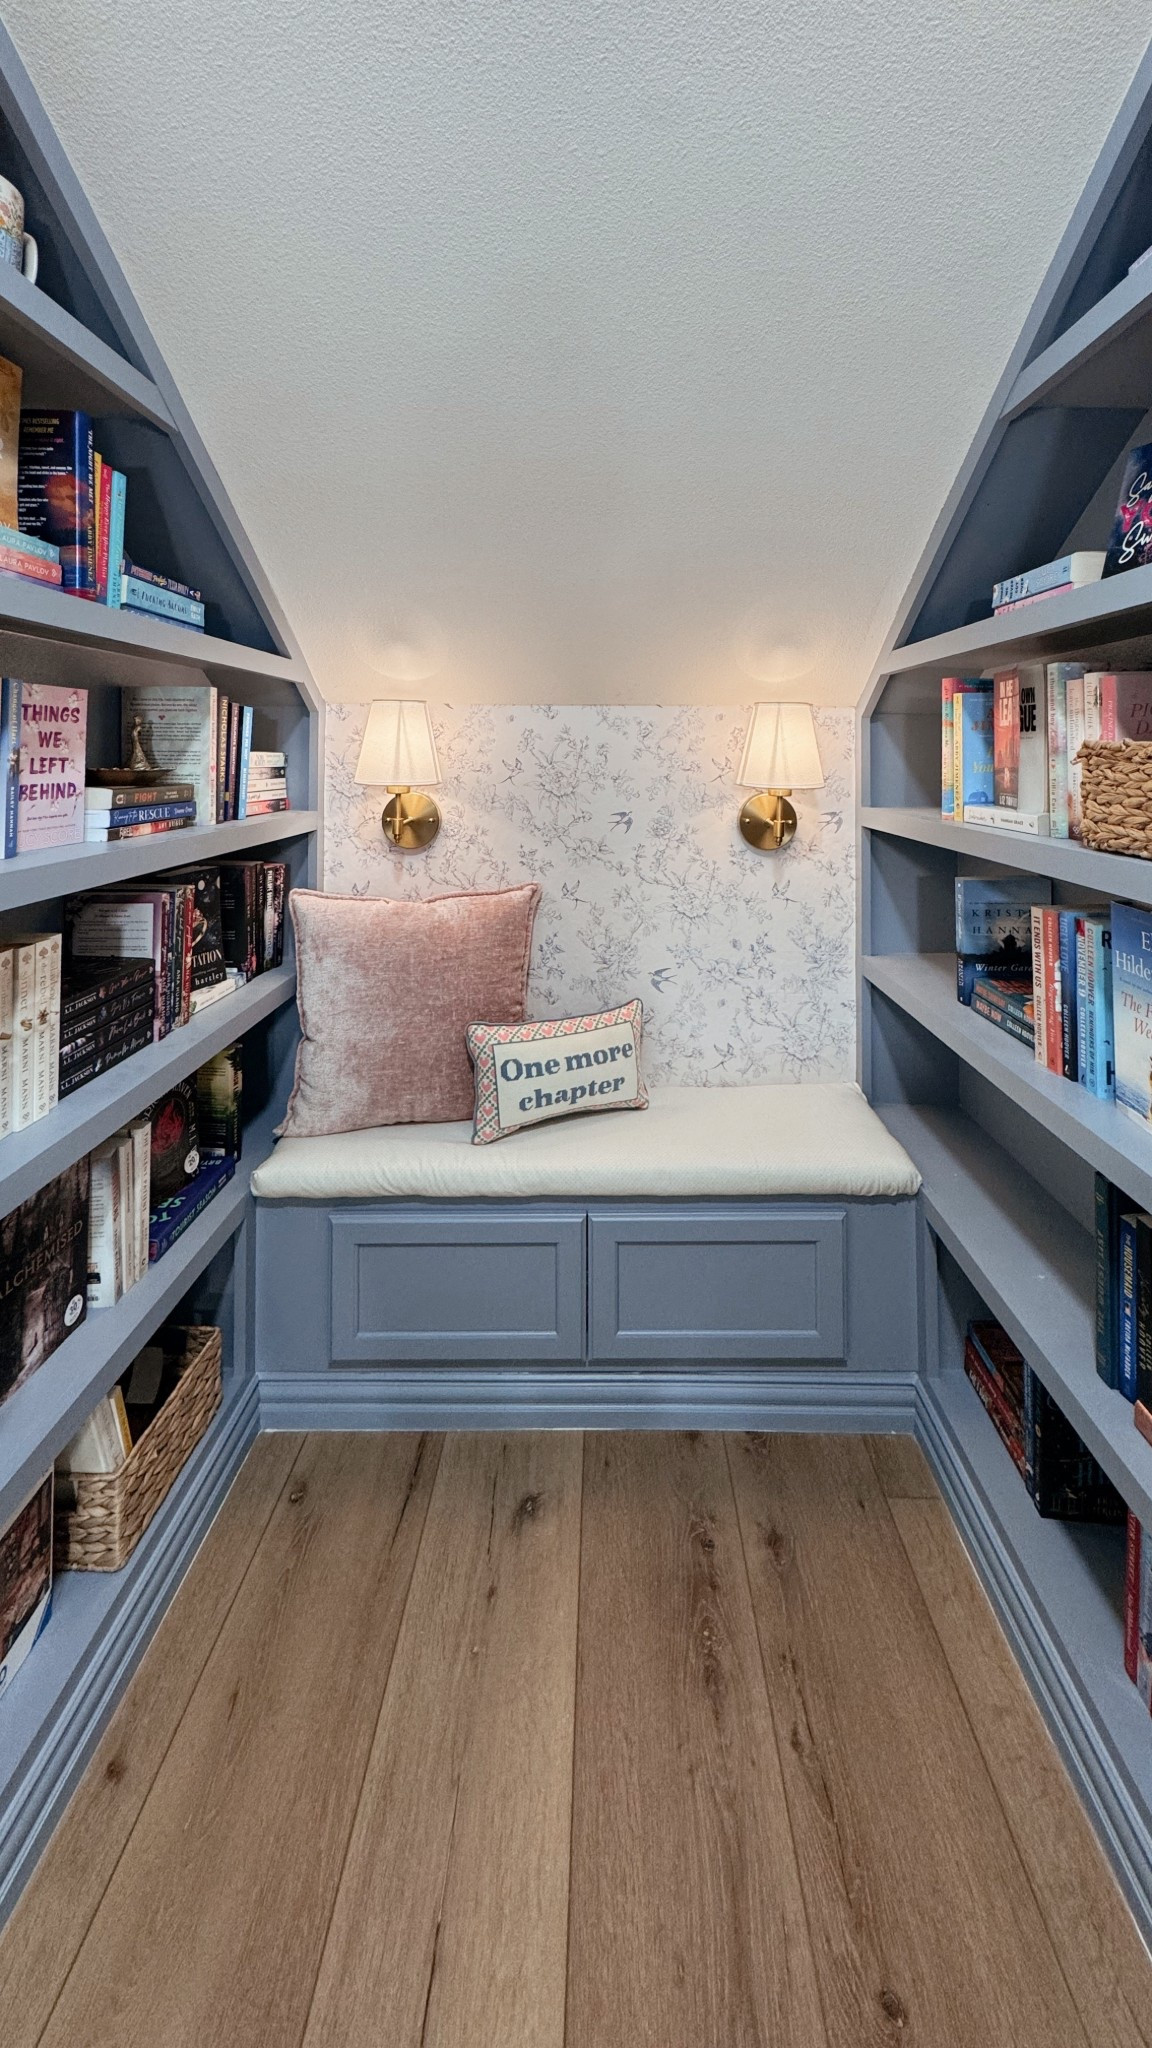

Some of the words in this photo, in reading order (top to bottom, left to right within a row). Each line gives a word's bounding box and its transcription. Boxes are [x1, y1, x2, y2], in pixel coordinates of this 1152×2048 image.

[88, 473, 94, 486] WE
[1126, 471, 1152, 508] Sa
[0, 535, 20, 546] AURA
[22, 542, 47, 556] PAVLOV
[24, 562, 50, 576] PAVLOV
[1020, 687, 1036, 704] OWN
[12, 712, 18, 723] of
[22, 704, 81, 724] THINGS
[1130, 703, 1152, 718] PI
[220, 699, 228, 748] NICHOLAS
[38, 730, 62, 748] WE
[30, 757, 70, 774] LEFT
[18, 782, 77, 802] BEHIND
[134, 792, 158, 803] FIGHT
[138, 806, 170, 822] RESCUE
[44, 828, 80, 844] SCORE
[1034, 916, 1040, 924] IT
[972, 926, 1032, 934] HANNA
[1060, 917, 1068, 946] UGLY
[192, 949, 222, 968] TATION
[974, 963, 1007, 972] Winter
[1060, 949, 1068, 972] LOVE
[1078, 934, 1086, 986] NOVEMBER
[1116, 950, 1152, 981] Hilde
[20, 971, 29, 1010] sinner
[40, 975, 48, 1005] rebel
[1036, 974, 1042, 988] US
[75, 994, 97, 1010] JACKSON
[1121, 991, 1142, 1014] The
[74, 1018, 96, 1035] JACKSON
[975, 1000, 992, 1016] MAYBE
[1006, 1020, 1022, 1035] COLLEEN
[73, 1043, 96, 1060] JACKSON
[1089, 1050, 1095, 1058] OF
[500, 1058, 560, 1082] One
[564, 1042, 634, 1072] more
[38, 1070, 46, 1100] MANN
[71, 1067, 94, 1085] JACKSON
[519, 1076, 626, 1112] chapter
[170, 1207, 196, 1240] TOURIST
[196, 1184, 217, 1210] SEASON
[1124, 1244, 1133, 1298] HOUSEMAID
[1124, 1318, 1132, 1344] FREIDA
